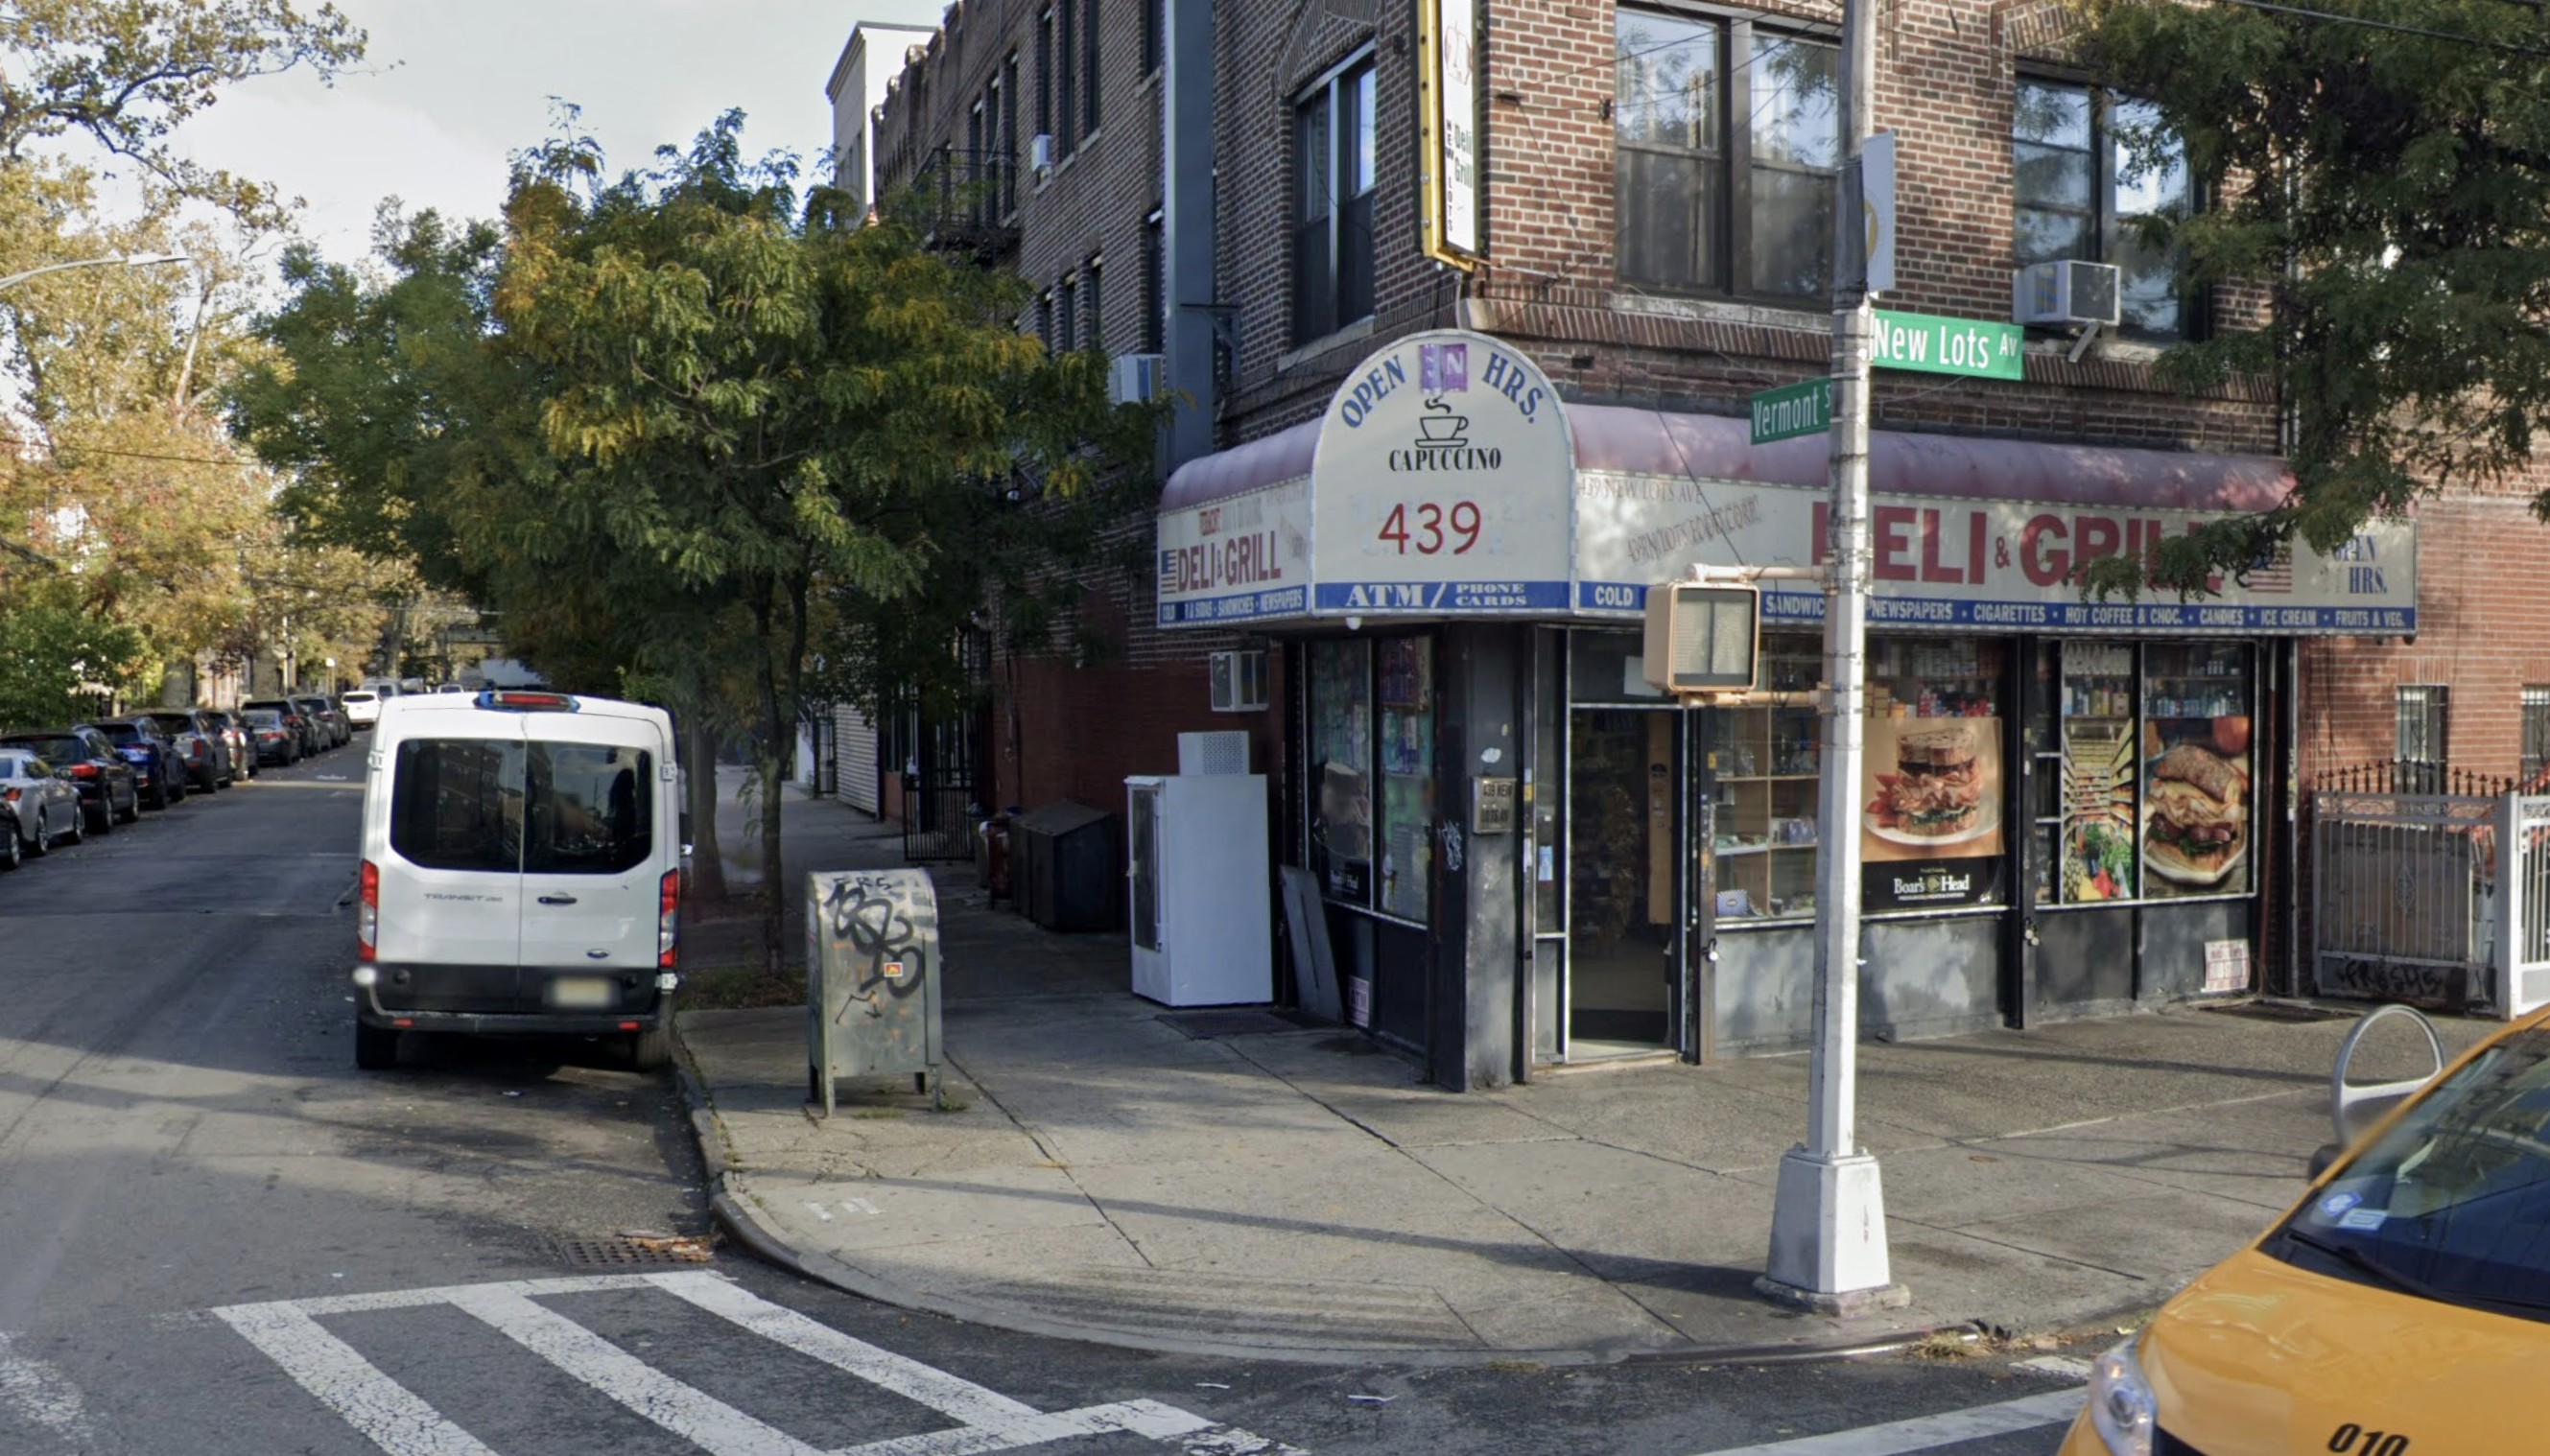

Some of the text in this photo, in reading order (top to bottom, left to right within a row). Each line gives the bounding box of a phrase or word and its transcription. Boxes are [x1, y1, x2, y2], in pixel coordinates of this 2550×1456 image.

[1874, 318, 2018, 369] New Lots Av
[1341, 352, 1544, 429] OPEN HRS.
[1754, 387, 1819, 436] Vermont
[1389, 446, 1501, 471] CAPUCCINO
[1641, 478, 1675, 503] LOTS
[1378, 501, 1481, 554] 439
[1178, 542, 1215, 592] DELI
[1225, 530, 1282, 586] GRILL
[1995, 536, 2011, 569] &
[1345, 584, 1425, 606] ATM
[1455, 583, 1525, 594] PHONE
[1455, 596, 1526, 606] CARDS
[1594, 586, 1633, 606] COLD
[1766, 596, 1825, 616] SANDWIC
[1872, 599, 1952, 620] NEWSPAPERS
[1973, 603, 2045, 623] CIGARETTES
[2066, 606, 2088, 623] HOT
[2092, 606, 2133, 624] COFFEE
[2137, 607, 2145, 624] &
[2200, 608, 2244, 625] CANDIES
[2261, 609, 2278, 625] ICE
[2281, 609, 2317, 625] CREAM
[2335, 610, 2369, 626] FRUITS
[1894, 874, 1970, 894] Boar's Head
[2327, 1422, 2410, 1456] 010
